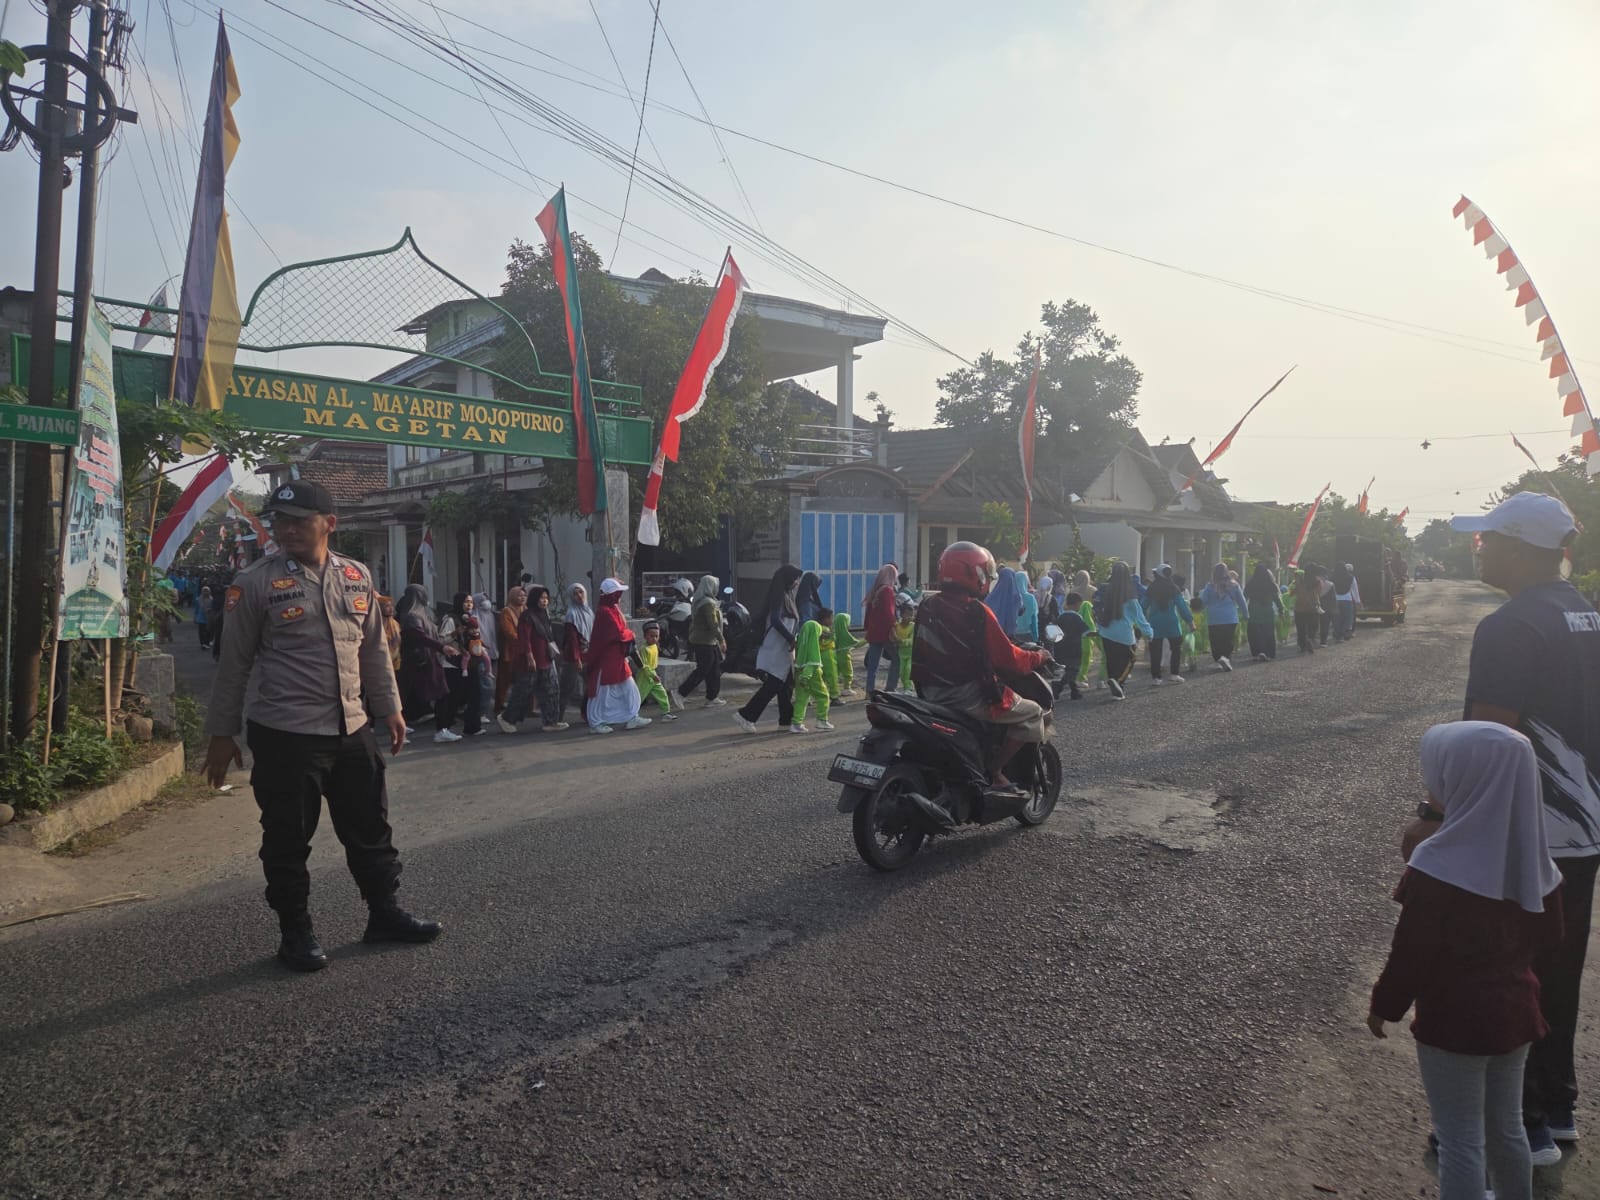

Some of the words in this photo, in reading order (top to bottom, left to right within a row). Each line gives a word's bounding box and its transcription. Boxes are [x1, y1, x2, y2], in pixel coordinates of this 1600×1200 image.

[225, 374, 318, 404] AYASAN
[325, 387, 354, 409] AL
[372, 392, 454, 420] MA'ARIF
[460, 403, 564, 434] MOJOPURNO
[16, 413, 76, 435] PAJANG
[303, 407, 508, 445] MAGETAN
[268, 590, 306, 604] FIRMAN
